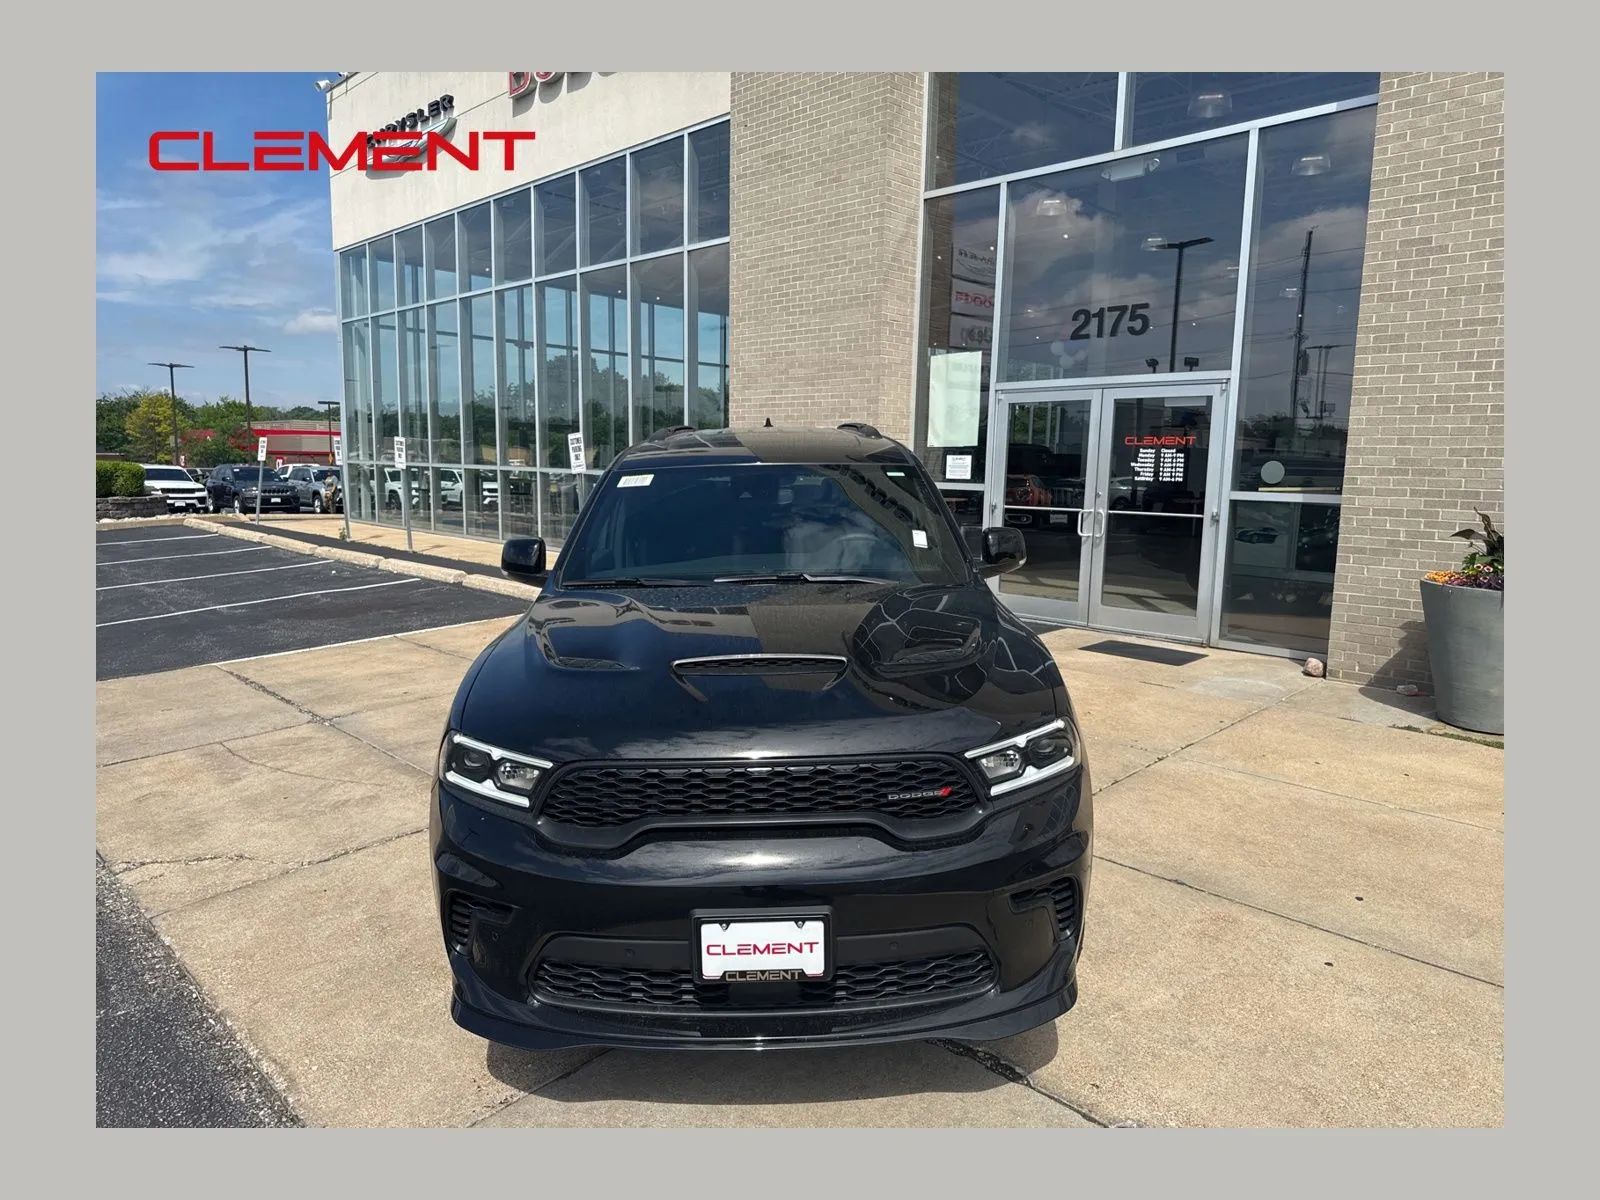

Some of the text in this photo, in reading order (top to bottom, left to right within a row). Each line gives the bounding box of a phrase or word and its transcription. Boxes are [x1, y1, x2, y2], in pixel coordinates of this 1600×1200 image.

[1070, 302, 1150, 340] 2175
[1125, 436, 1197, 446] CLEMENT
[706, 942, 819, 955] CLEMENT
[725, 970, 802, 981] CLEMENT
